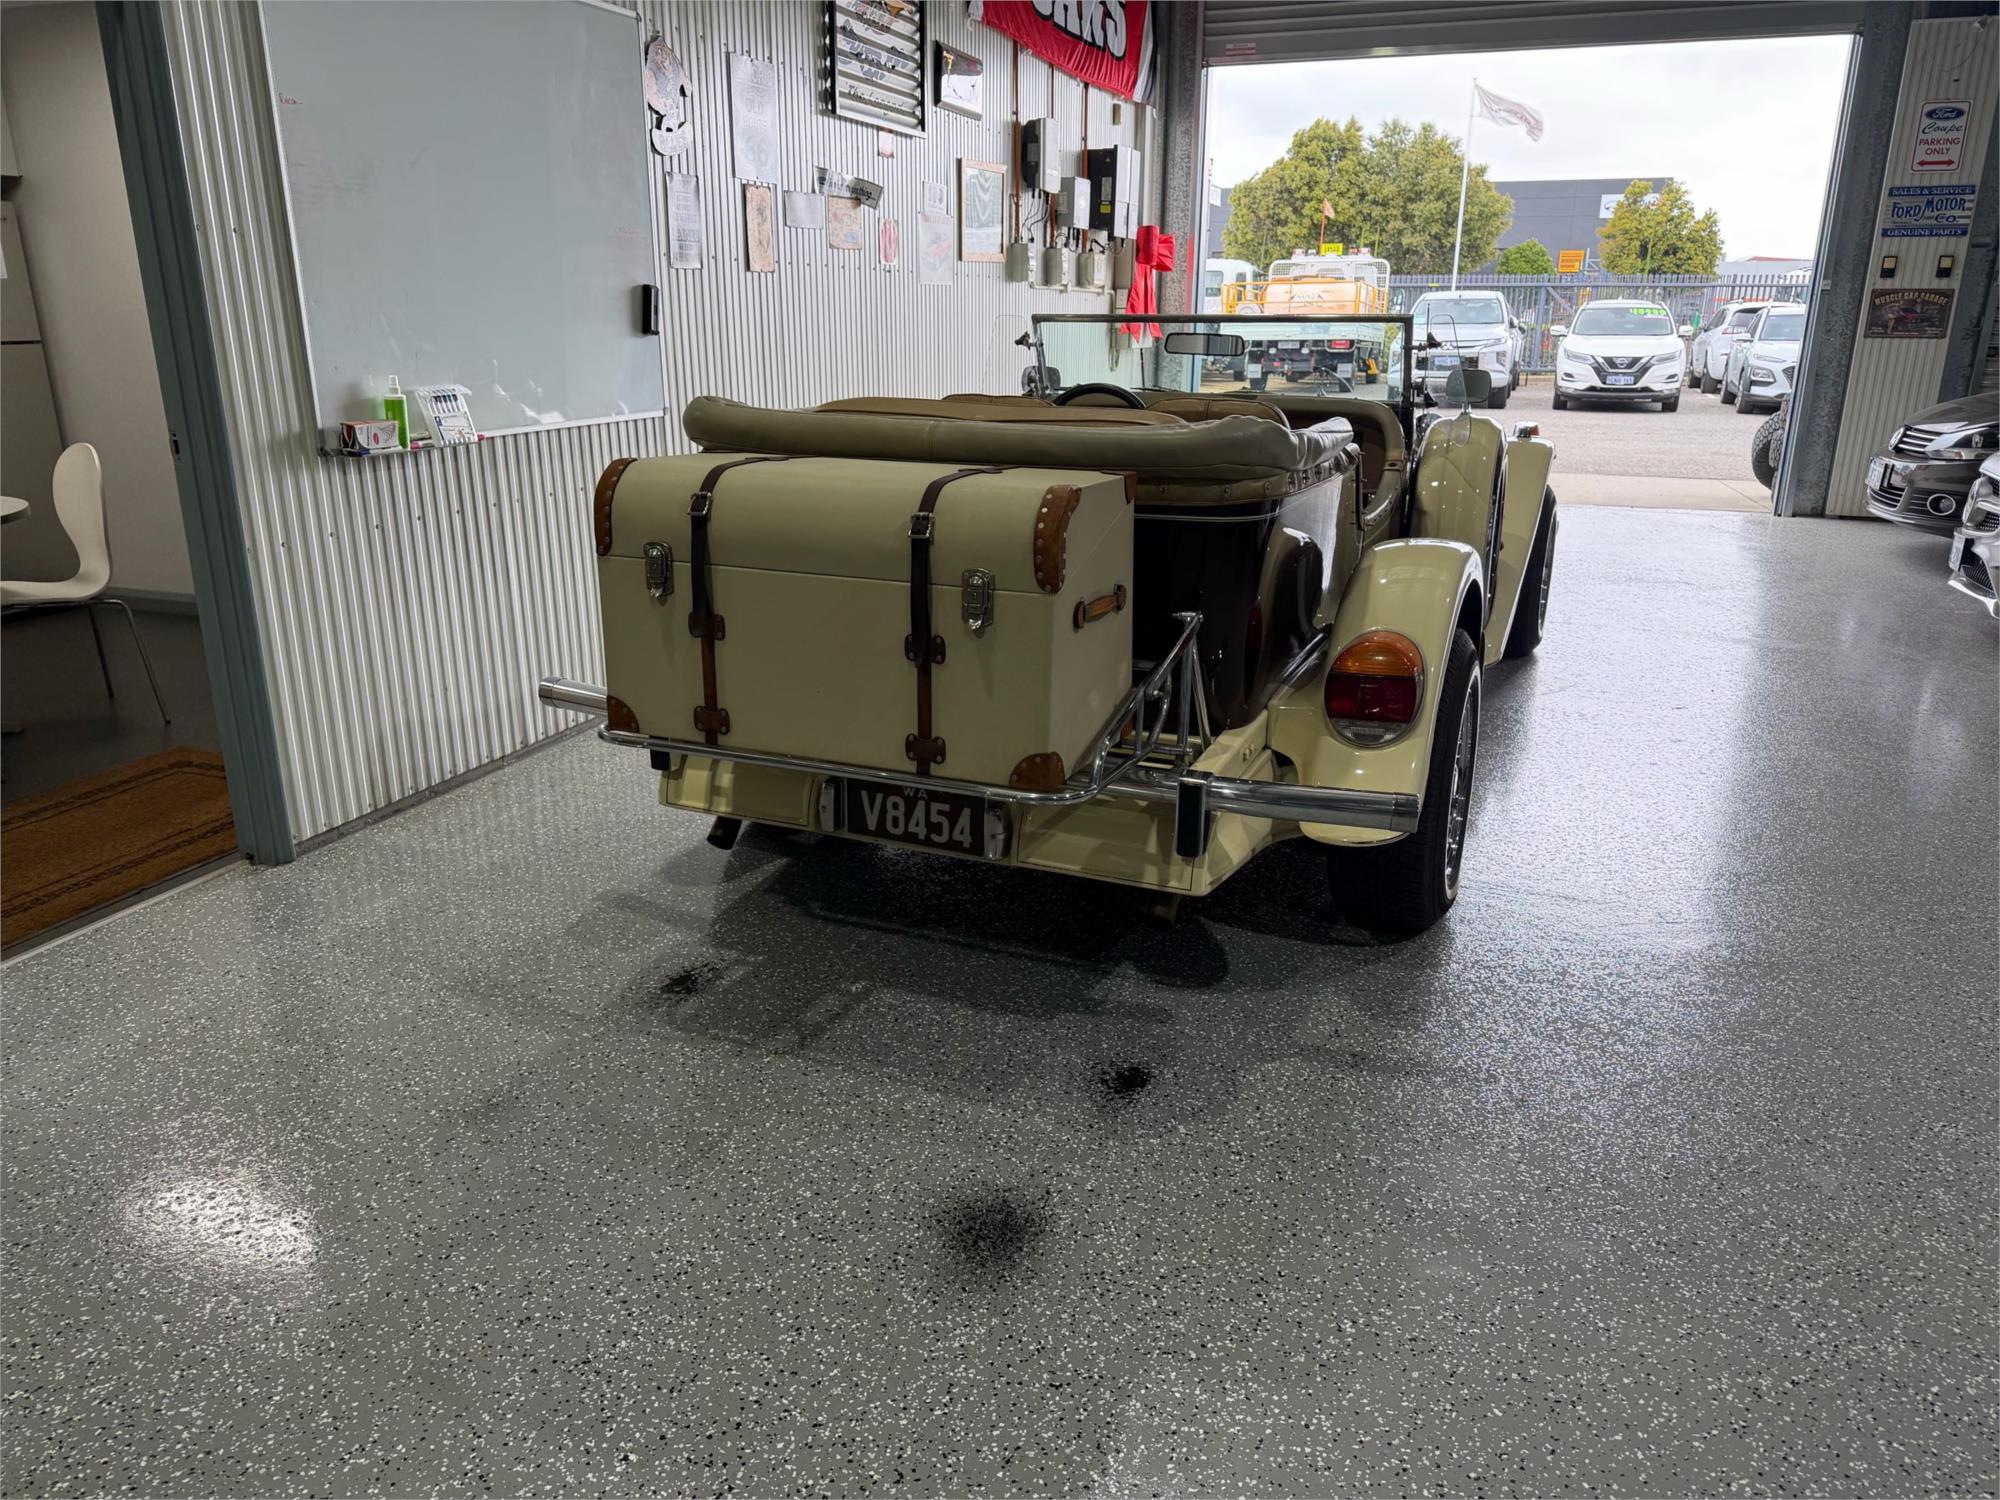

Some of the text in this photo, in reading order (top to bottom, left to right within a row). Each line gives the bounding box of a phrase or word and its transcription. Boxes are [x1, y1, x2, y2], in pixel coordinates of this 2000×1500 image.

[1921, 122, 1963, 135] Coupe
[1919, 137, 1960, 146] PARKING
[1925, 147, 1951, 156] ONLY
[1892, 187, 1921, 195] SALES
[1931, 186, 1972, 194] SERVICE
[1891, 197, 1968, 218] FORD MOTOR
[1887, 228, 1930, 236] GENUINE
[904, 786, 928, 800] WA
[860, 790, 972, 848] V8454
